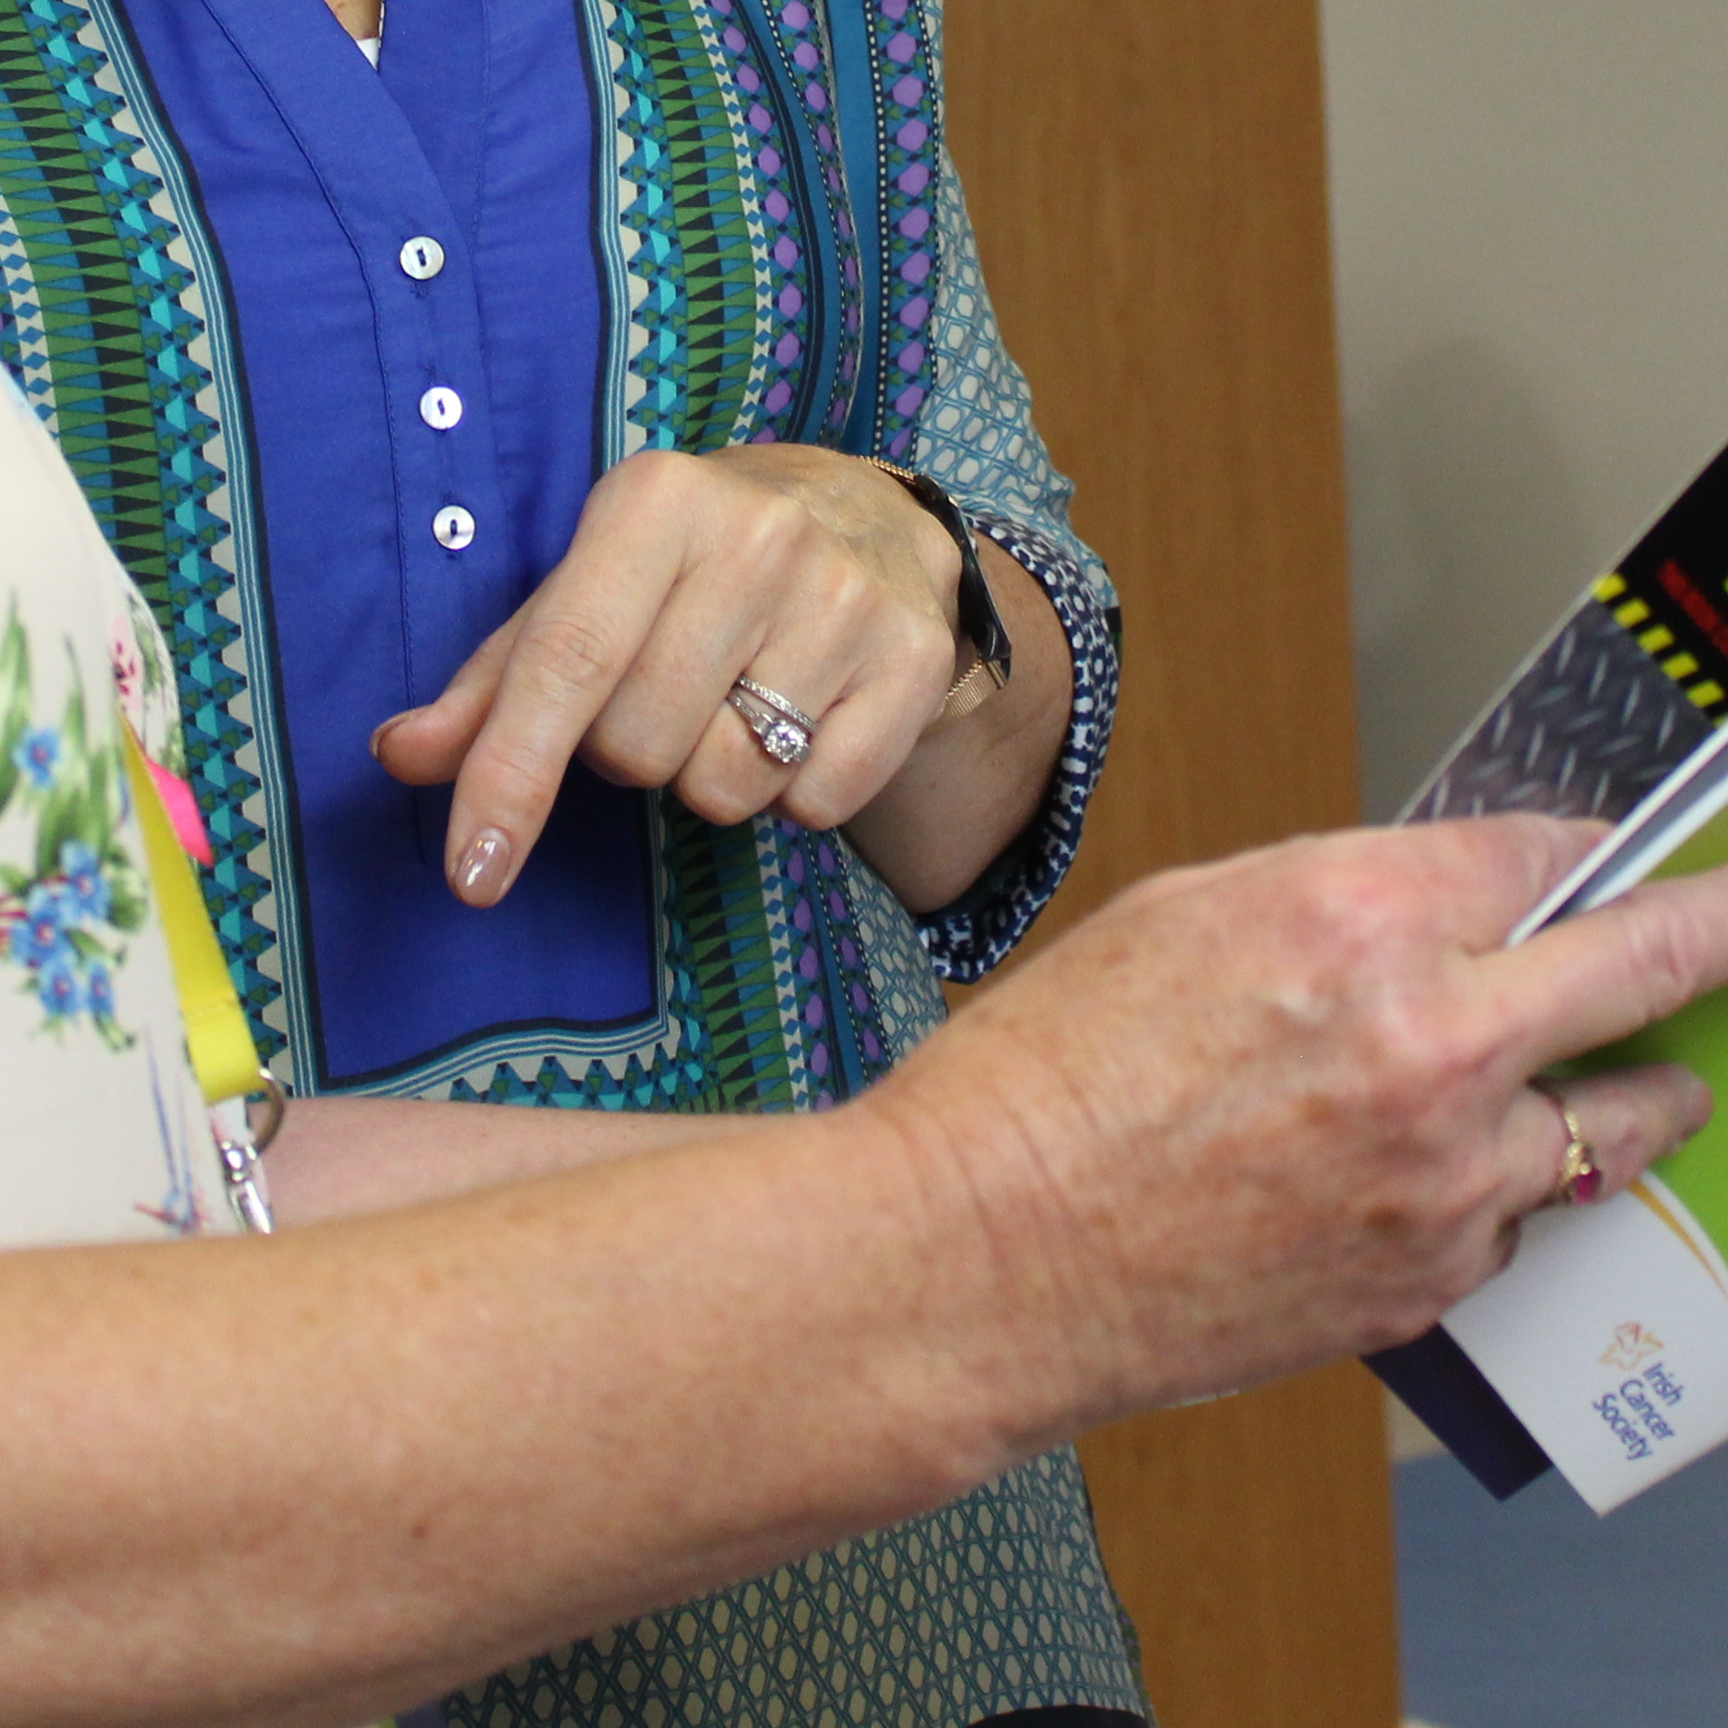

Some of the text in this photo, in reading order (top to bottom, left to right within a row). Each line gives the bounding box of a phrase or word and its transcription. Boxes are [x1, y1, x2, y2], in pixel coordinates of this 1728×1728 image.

[1620, 1378, 1675, 1442] Cancer
[1643, 1361, 1684, 1408] Irish
[1592, 1392, 1654, 1461] Society
